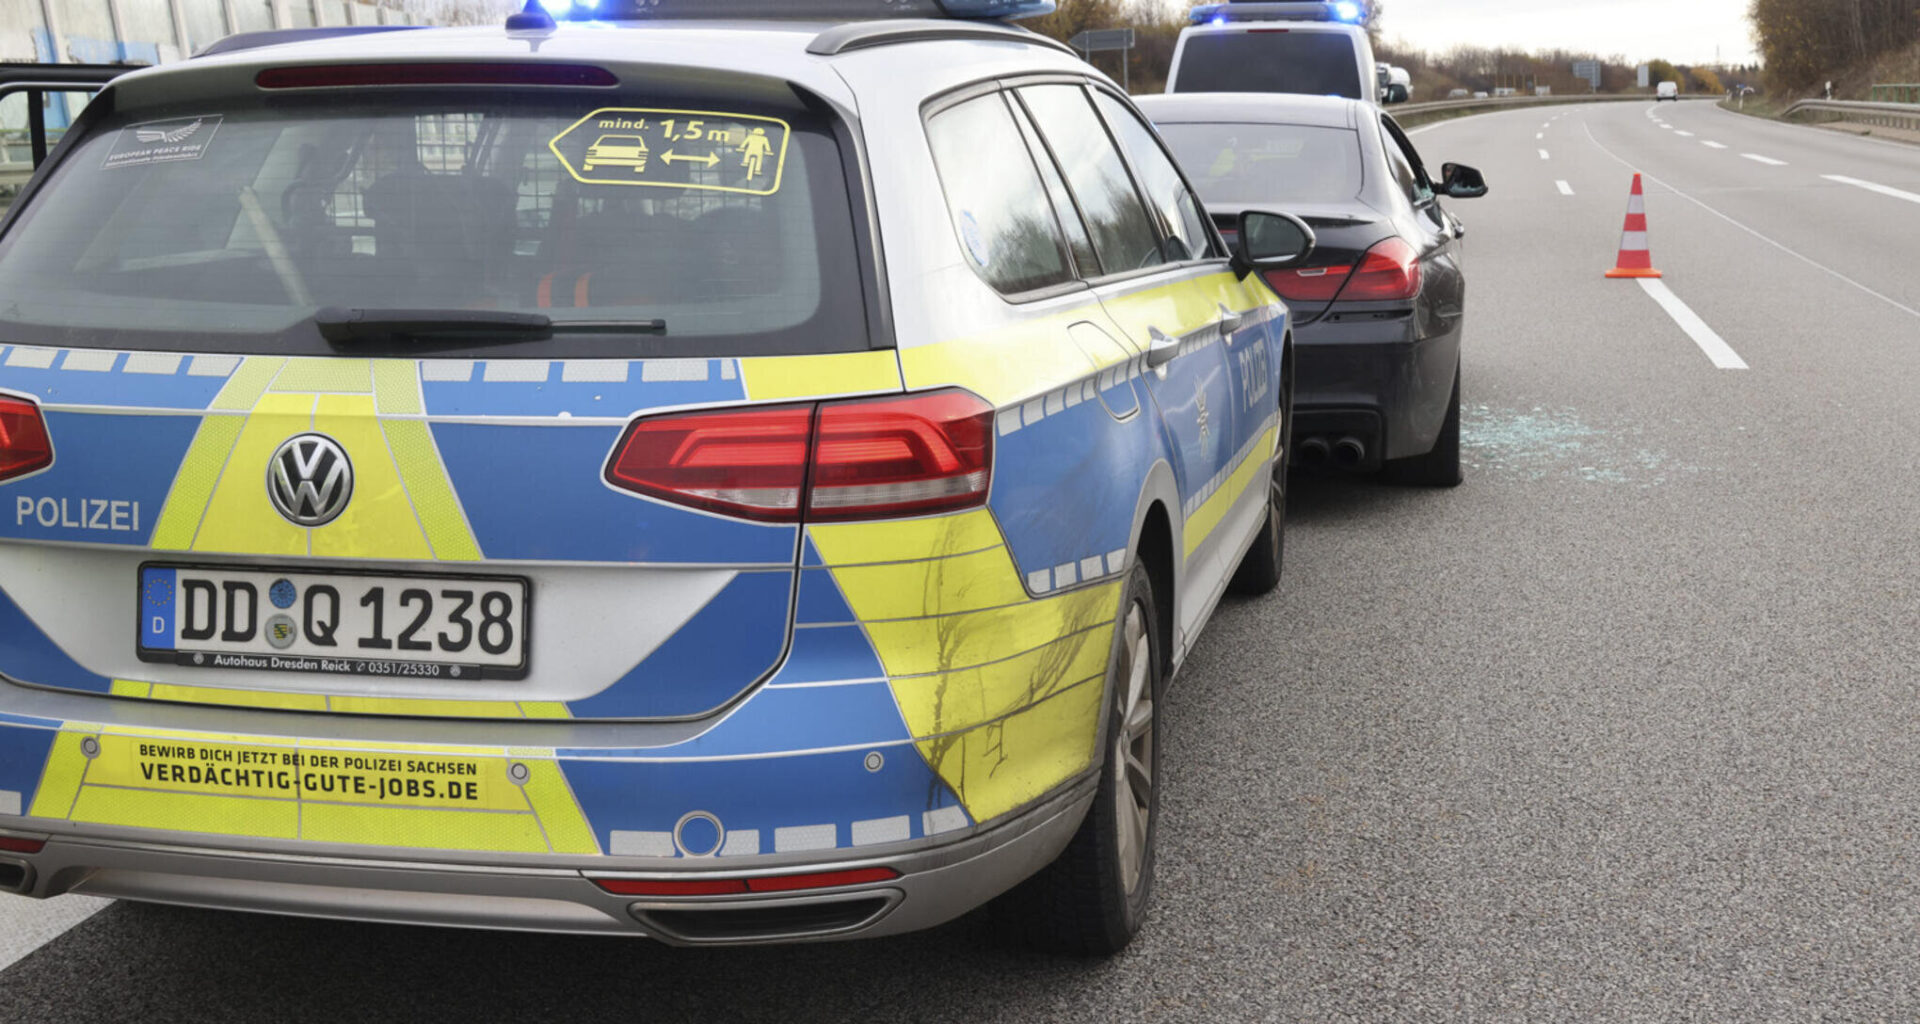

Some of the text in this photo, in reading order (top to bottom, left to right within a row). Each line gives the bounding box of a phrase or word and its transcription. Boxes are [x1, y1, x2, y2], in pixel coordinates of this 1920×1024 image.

[598, 117, 730, 142] mind. 1,5 m
[109, 149, 153, 161] EUROPEAN
[153, 146, 180, 155] PEACE
[1239, 338, 1268, 413] POLIZEI
[16, 496, 139, 531] POLIZEI
[152, 616, 165, 634] D
[181, 579, 514, 655] DD Q 1238
[214, 654, 440, 676] Autohaus Dresden Reick 0351/25330
[140, 744, 477, 775] BEWIRB DICH JETZT BEI DER POLIZEI SACHSEN
[140, 762, 478, 801] VERDÄCHTIG-GUTE-JOBS.DE
